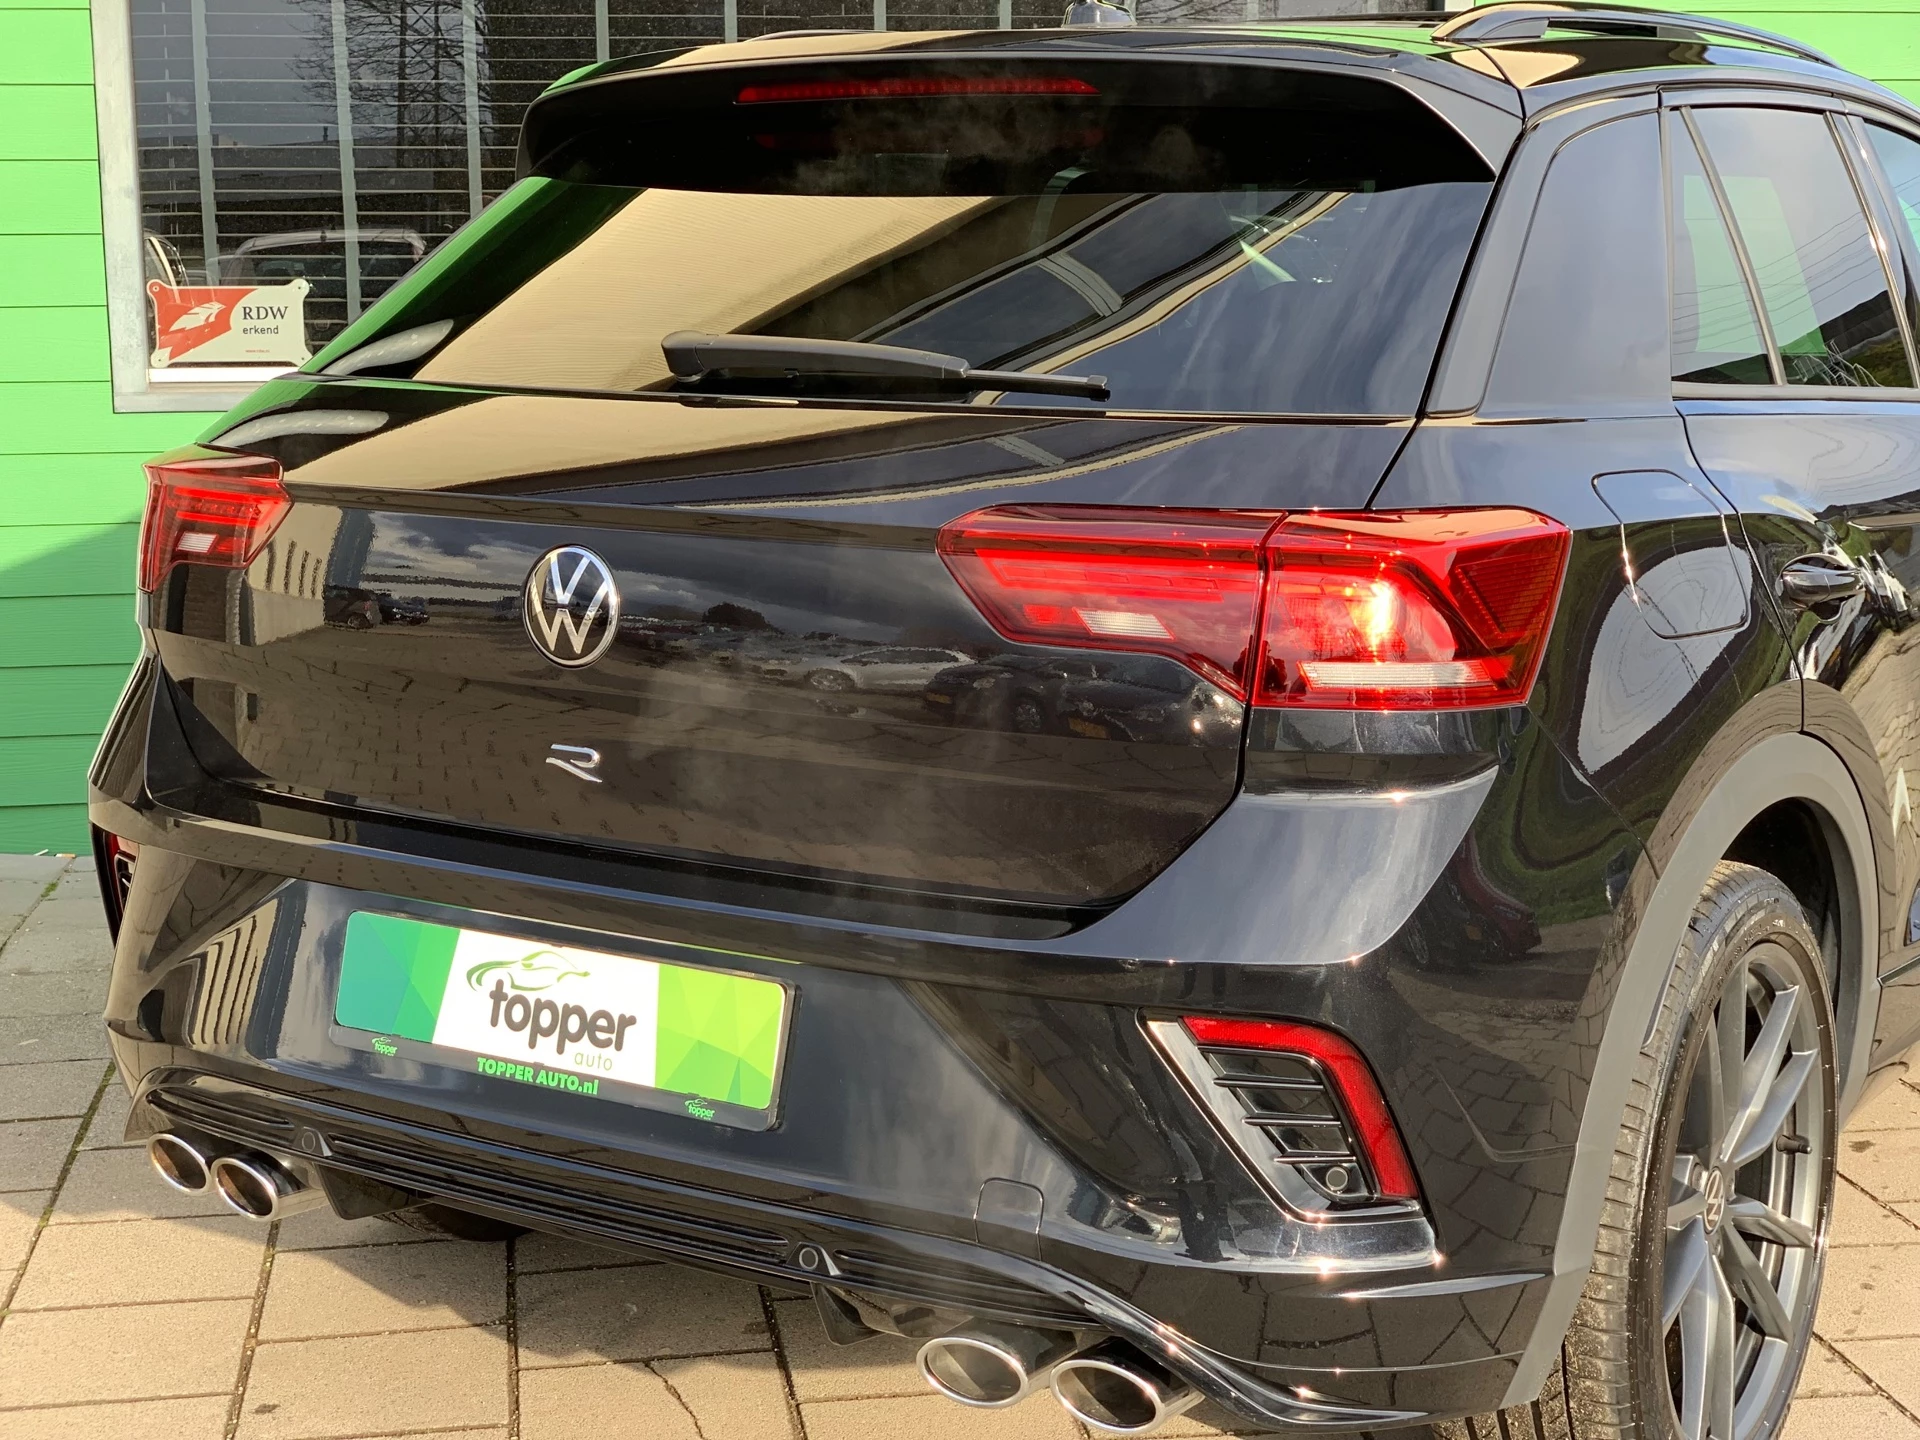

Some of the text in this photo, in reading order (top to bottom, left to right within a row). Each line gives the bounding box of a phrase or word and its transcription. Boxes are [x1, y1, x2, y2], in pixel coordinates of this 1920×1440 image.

[242, 306, 289, 320] RDW
[242, 325, 279, 335] erkend
[489, 978, 637, 1055] topper
[374, 1041, 398, 1054] topper
[574, 1052, 613, 1071] auto
[477, 1057, 599, 1095] TOPPER AUTO.nl
[688, 1104, 715, 1118] topper
